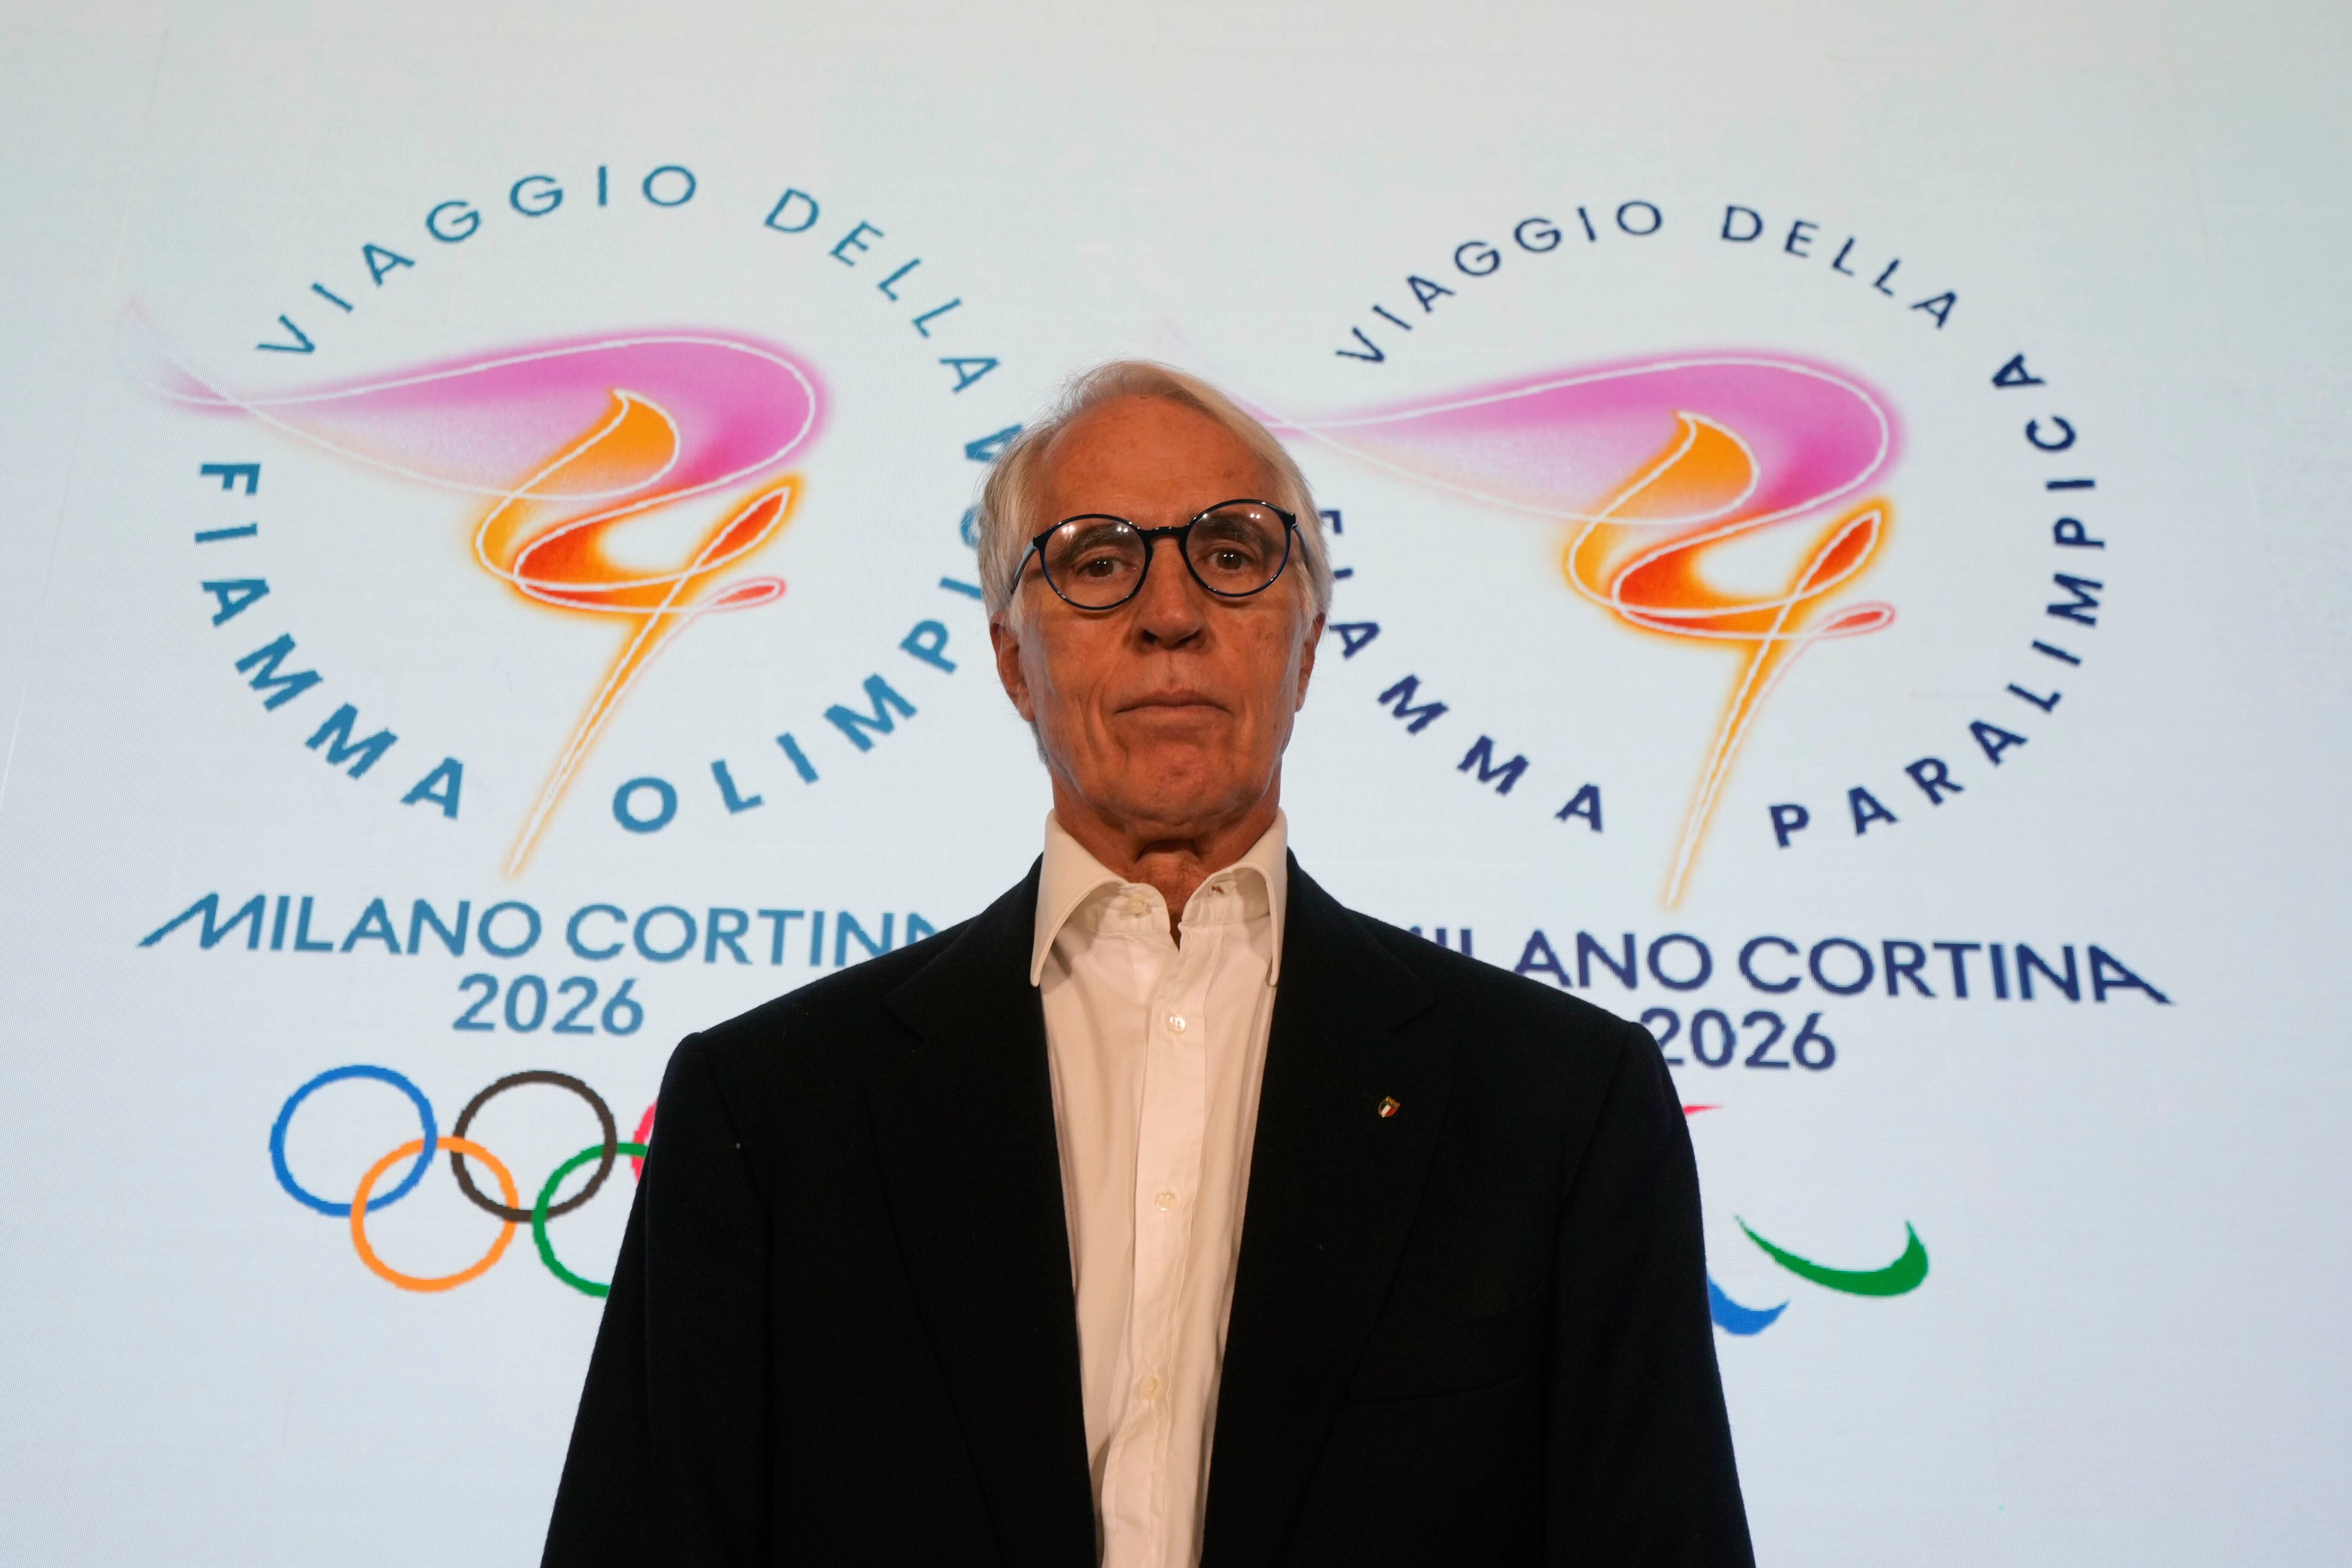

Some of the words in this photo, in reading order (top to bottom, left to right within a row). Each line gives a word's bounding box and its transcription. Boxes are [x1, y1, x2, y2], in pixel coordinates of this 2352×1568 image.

[256, 164, 698, 356] VIAGGIO
[763, 187, 1001, 393] DELLA
[1335, 200, 1664, 363] VIAGGIO
[1721, 204, 1959, 329] DELLA
[193, 462, 464, 820] FIAMMA
[1768, 352, 2107, 848] PARALIMPICA
[137, 891, 543, 959] MILANO
[1408, 925, 1714, 992] ANO
[1737, 935, 2173, 1006] CORTINA
[452, 972, 644, 1036] 2026
[1639, 1006, 1837, 1072] 2026
